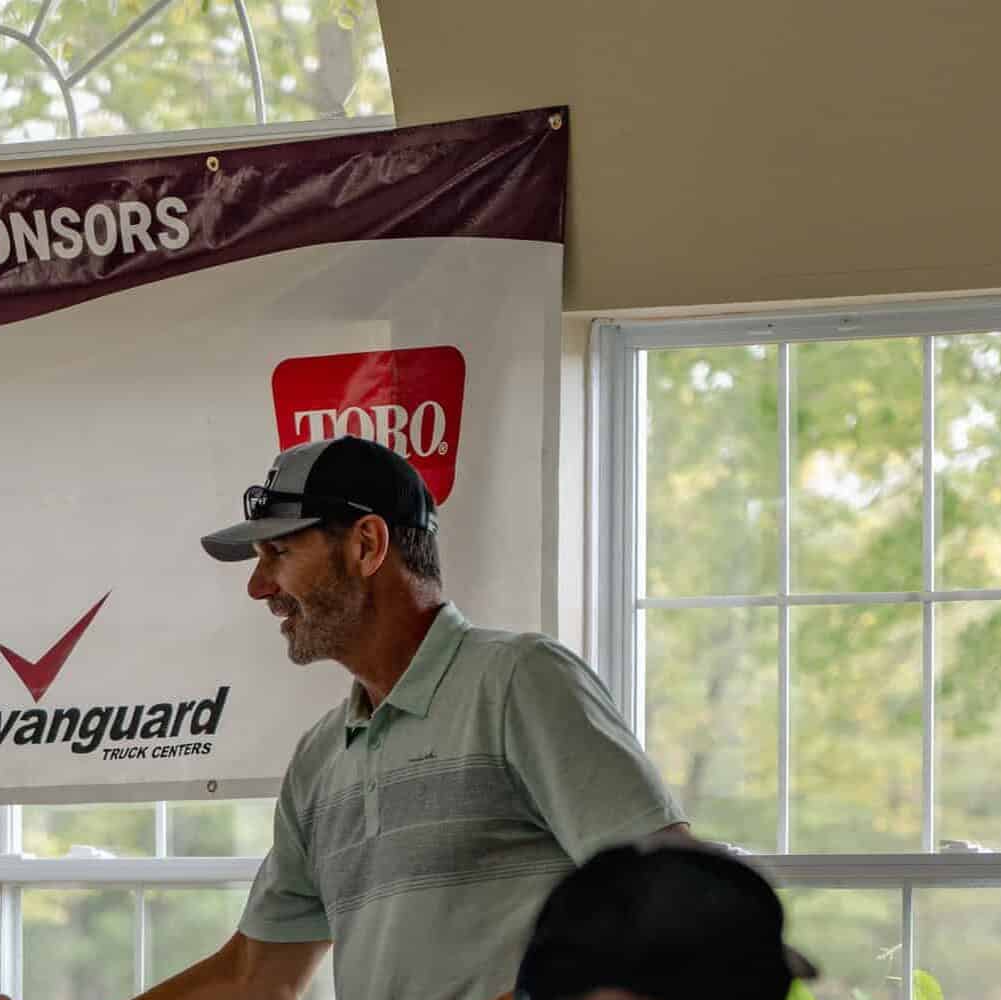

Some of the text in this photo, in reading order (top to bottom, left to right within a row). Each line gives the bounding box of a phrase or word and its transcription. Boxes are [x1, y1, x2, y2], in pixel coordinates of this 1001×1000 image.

[294, 400, 447, 458] TORO
[102, 742, 213, 761] TRUCK CENTERS
